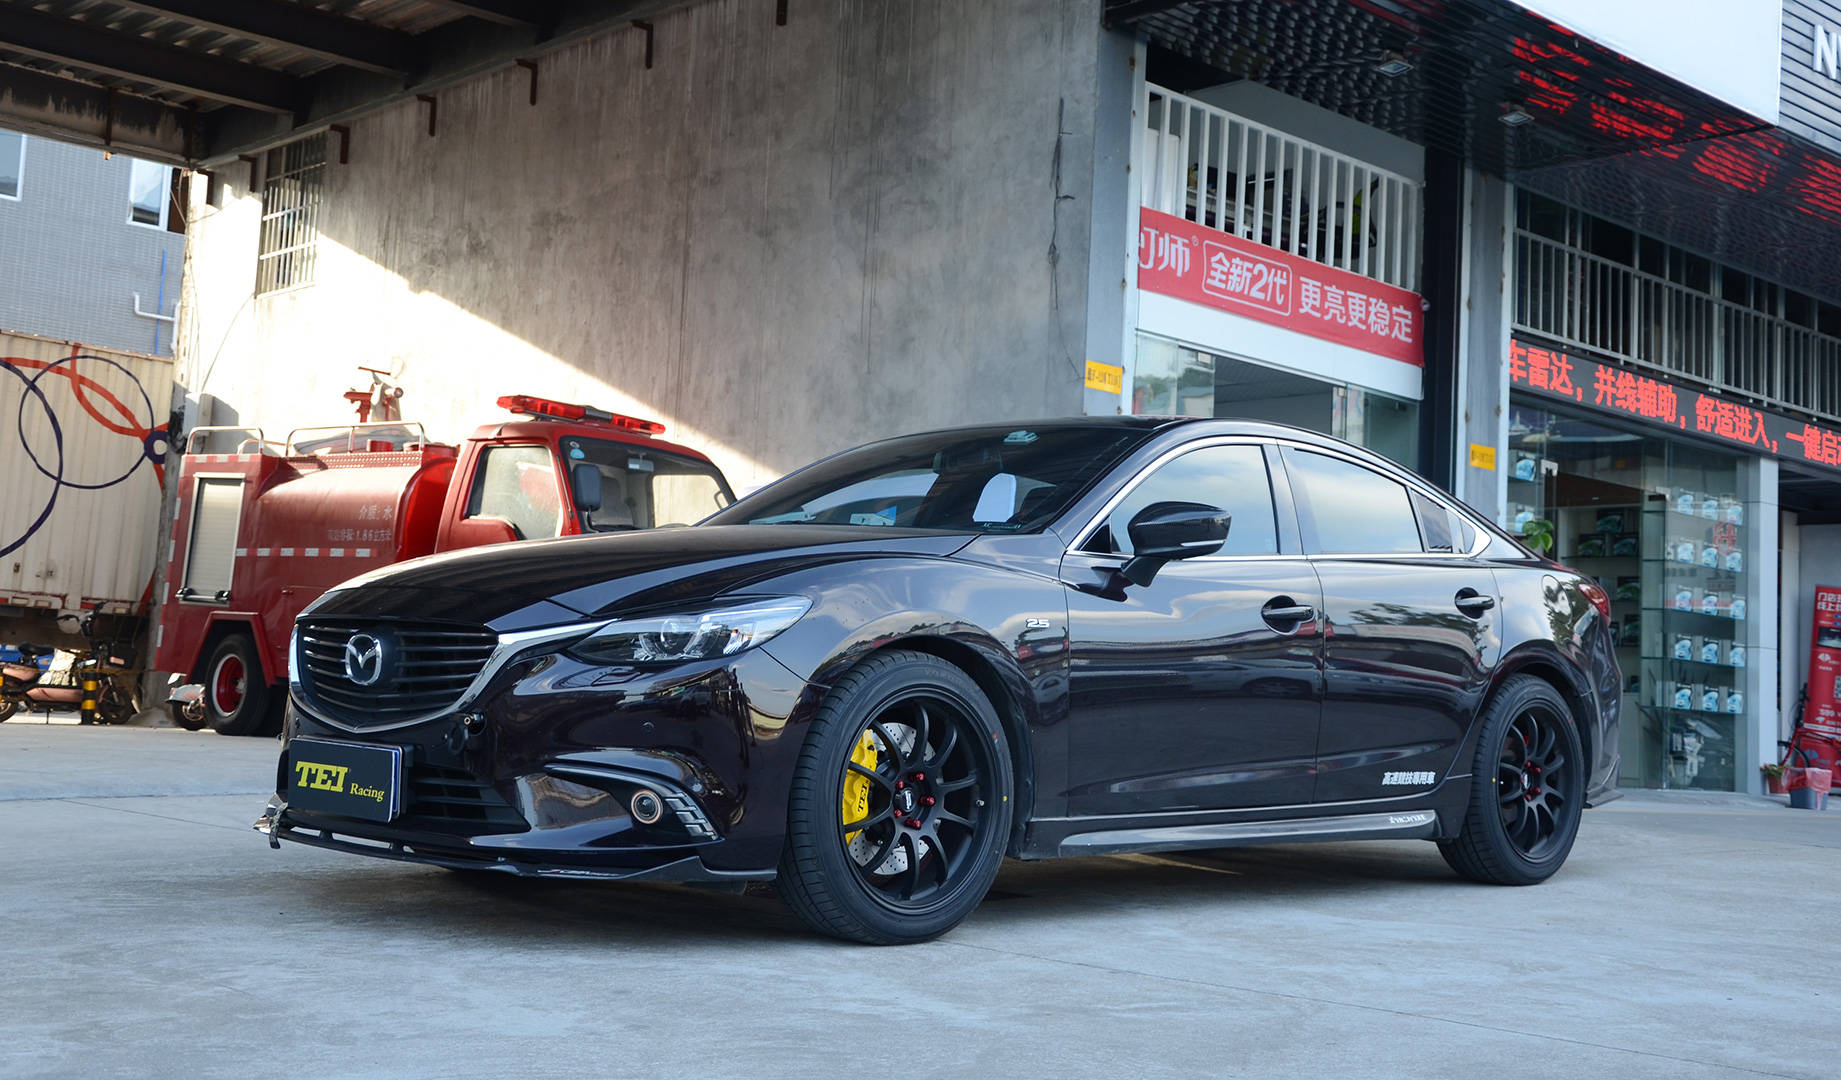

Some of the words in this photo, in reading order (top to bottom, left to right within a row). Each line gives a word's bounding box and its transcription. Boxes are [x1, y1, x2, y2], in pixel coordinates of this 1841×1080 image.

[1206, 251, 1289, 306] 全新2代
[1299, 275, 1413, 344] 更亮更稳定
[1785, 423, 1841, 467] 一键启
[296, 761, 349, 793] TEI
[350, 783, 385, 802] Racing
